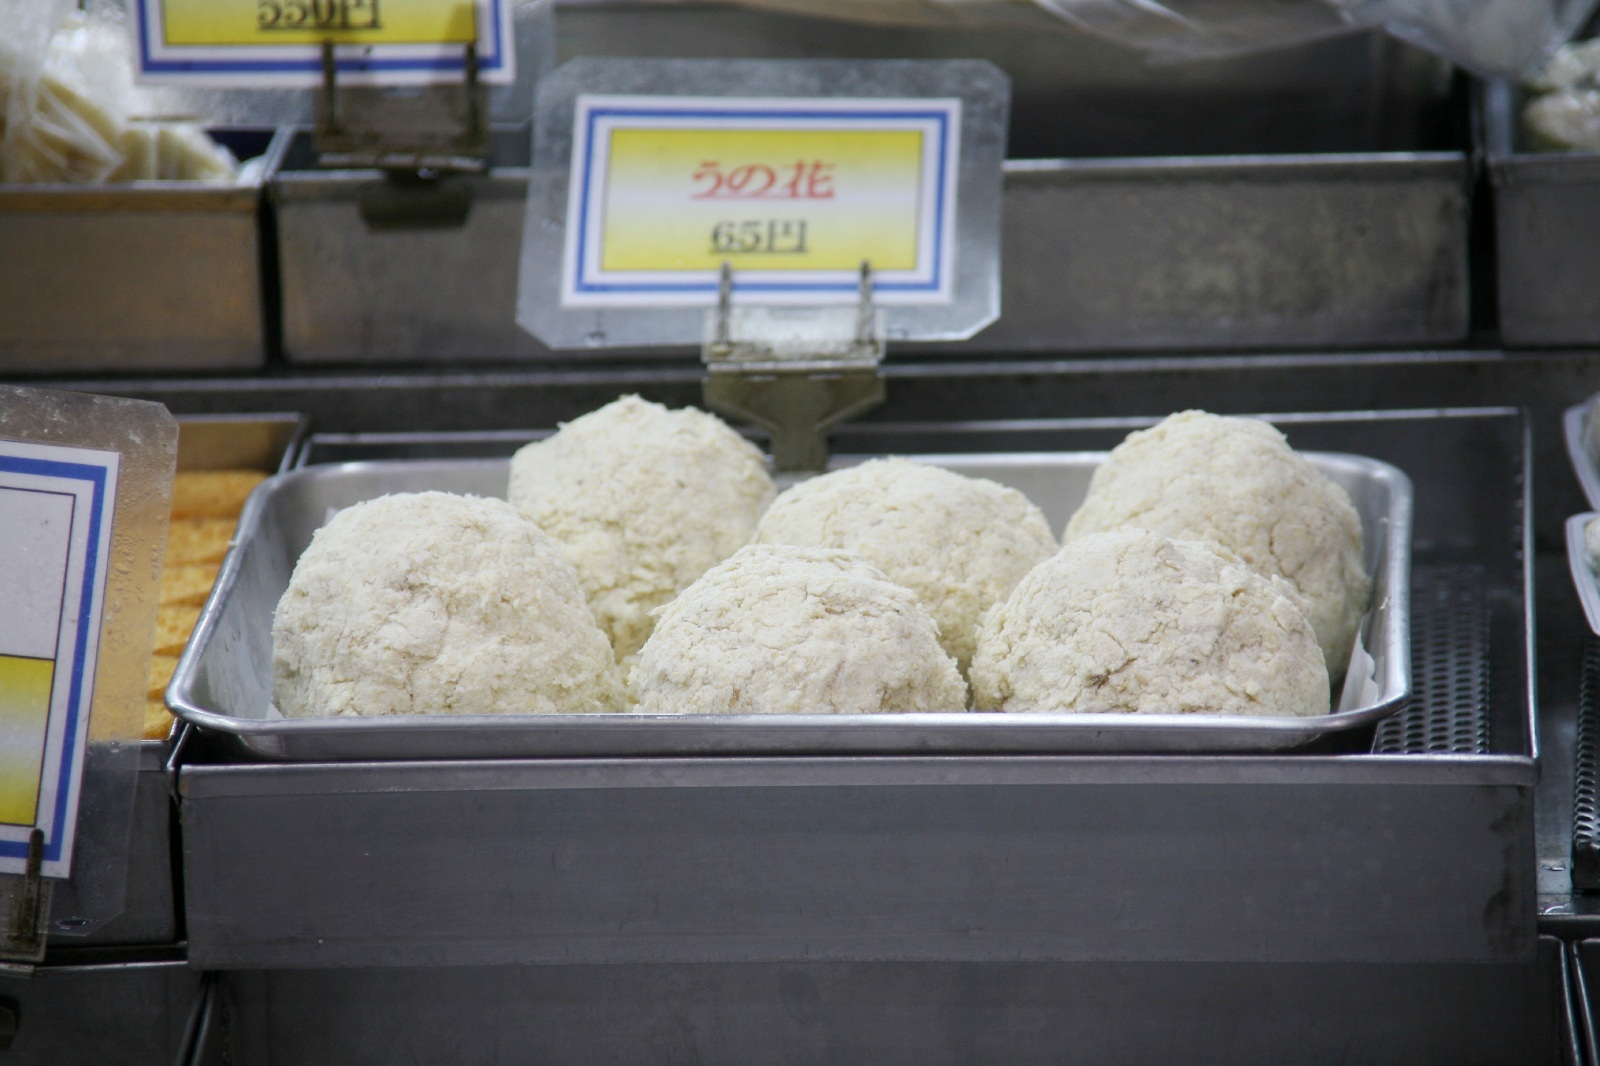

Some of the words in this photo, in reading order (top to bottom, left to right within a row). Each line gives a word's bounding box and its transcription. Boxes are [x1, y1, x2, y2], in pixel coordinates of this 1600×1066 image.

[258, 0, 380, 29] 550円
[693, 160, 835, 198] うの花
[711, 219, 808, 252] 65円
